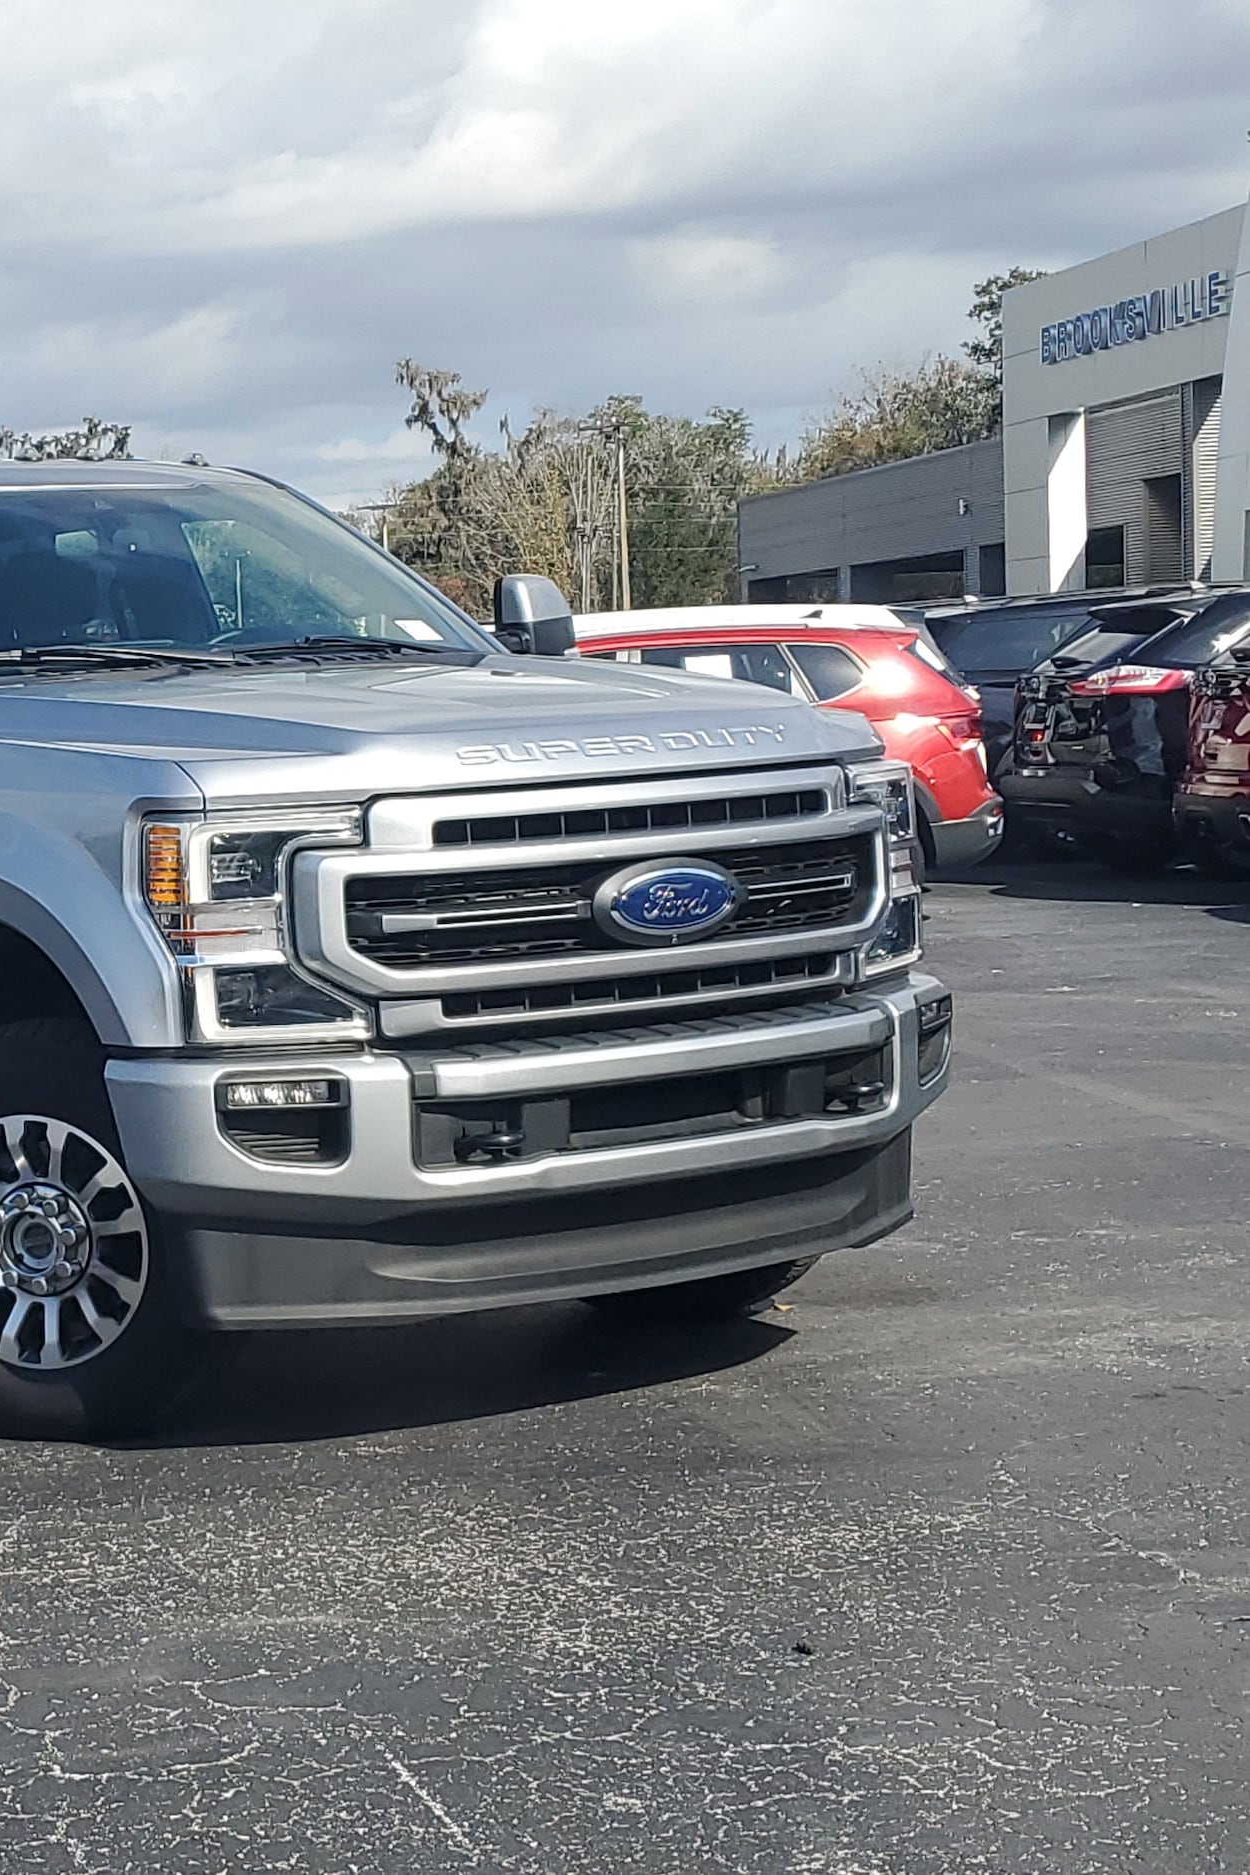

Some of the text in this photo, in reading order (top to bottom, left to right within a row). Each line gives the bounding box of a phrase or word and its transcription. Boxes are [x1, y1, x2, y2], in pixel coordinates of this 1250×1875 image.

[1039, 270, 1227, 366] BROOKSVILLE
[455, 723, 786, 766] SUPER DUTY
[642, 882, 711, 921] Ford
